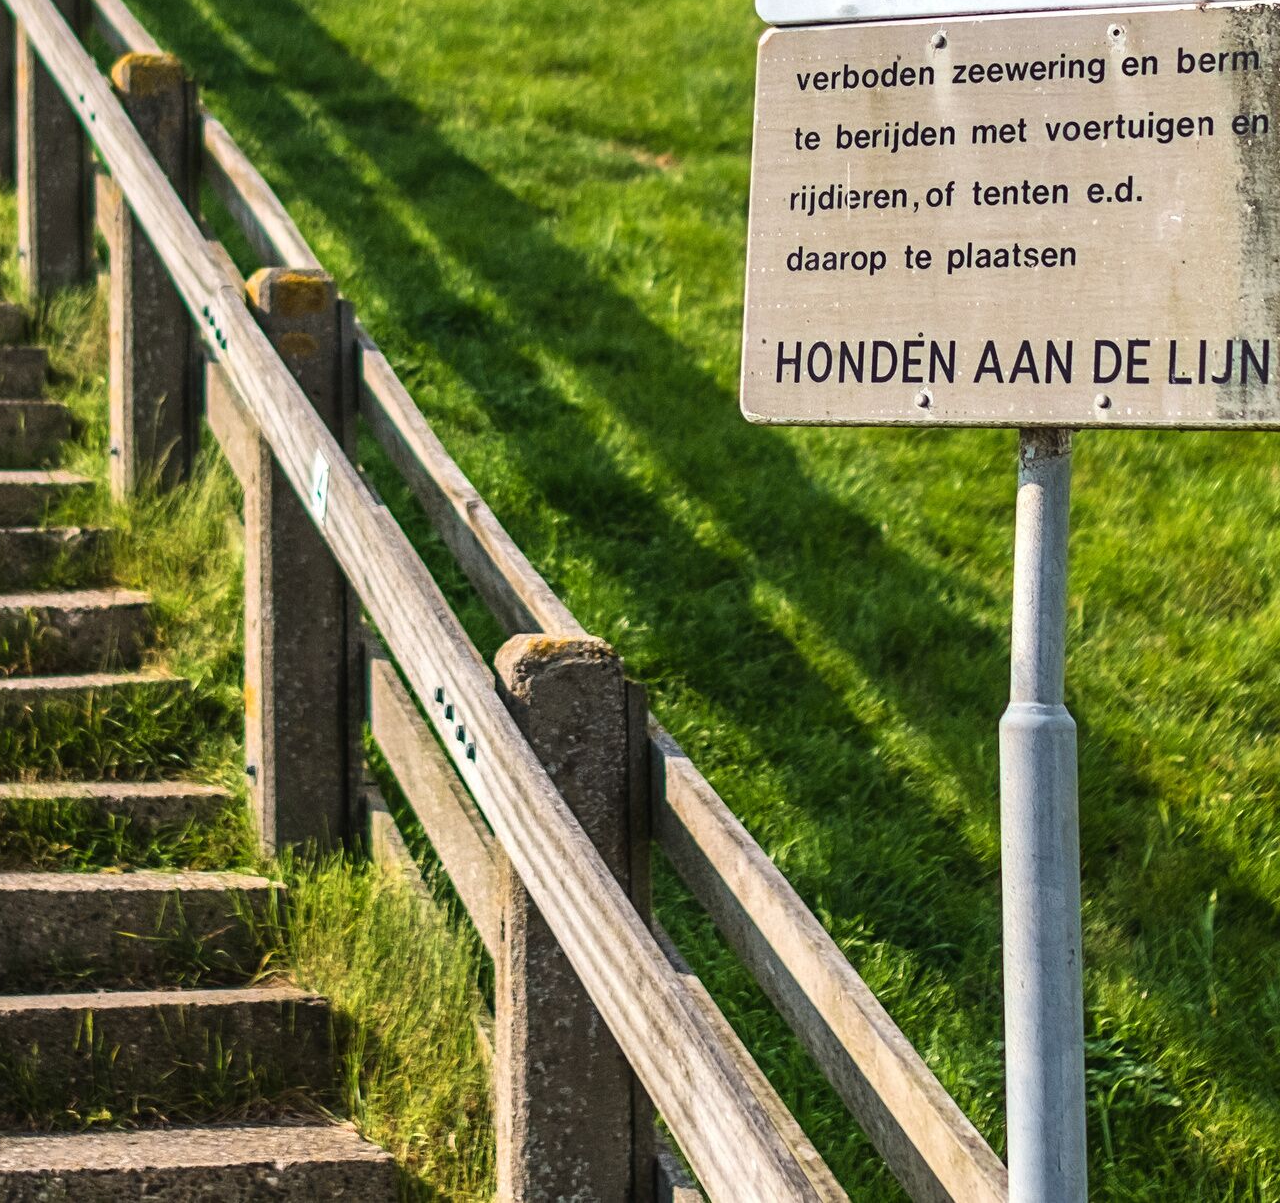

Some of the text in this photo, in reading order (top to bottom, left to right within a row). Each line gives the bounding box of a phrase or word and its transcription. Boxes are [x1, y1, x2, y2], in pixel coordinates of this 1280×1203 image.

[796, 47, 1261, 91] verboden zeewering en berm
[794, 111, 1270, 153] te berijden met voertuigen en
[972, 181, 1069, 207] tenten
[1087, 175, 1143, 204] e.d.
[786, 243, 1077, 275] daarop te plaatsen
[775, 339, 1271, 385] HONDEN AAN DE LIJN
